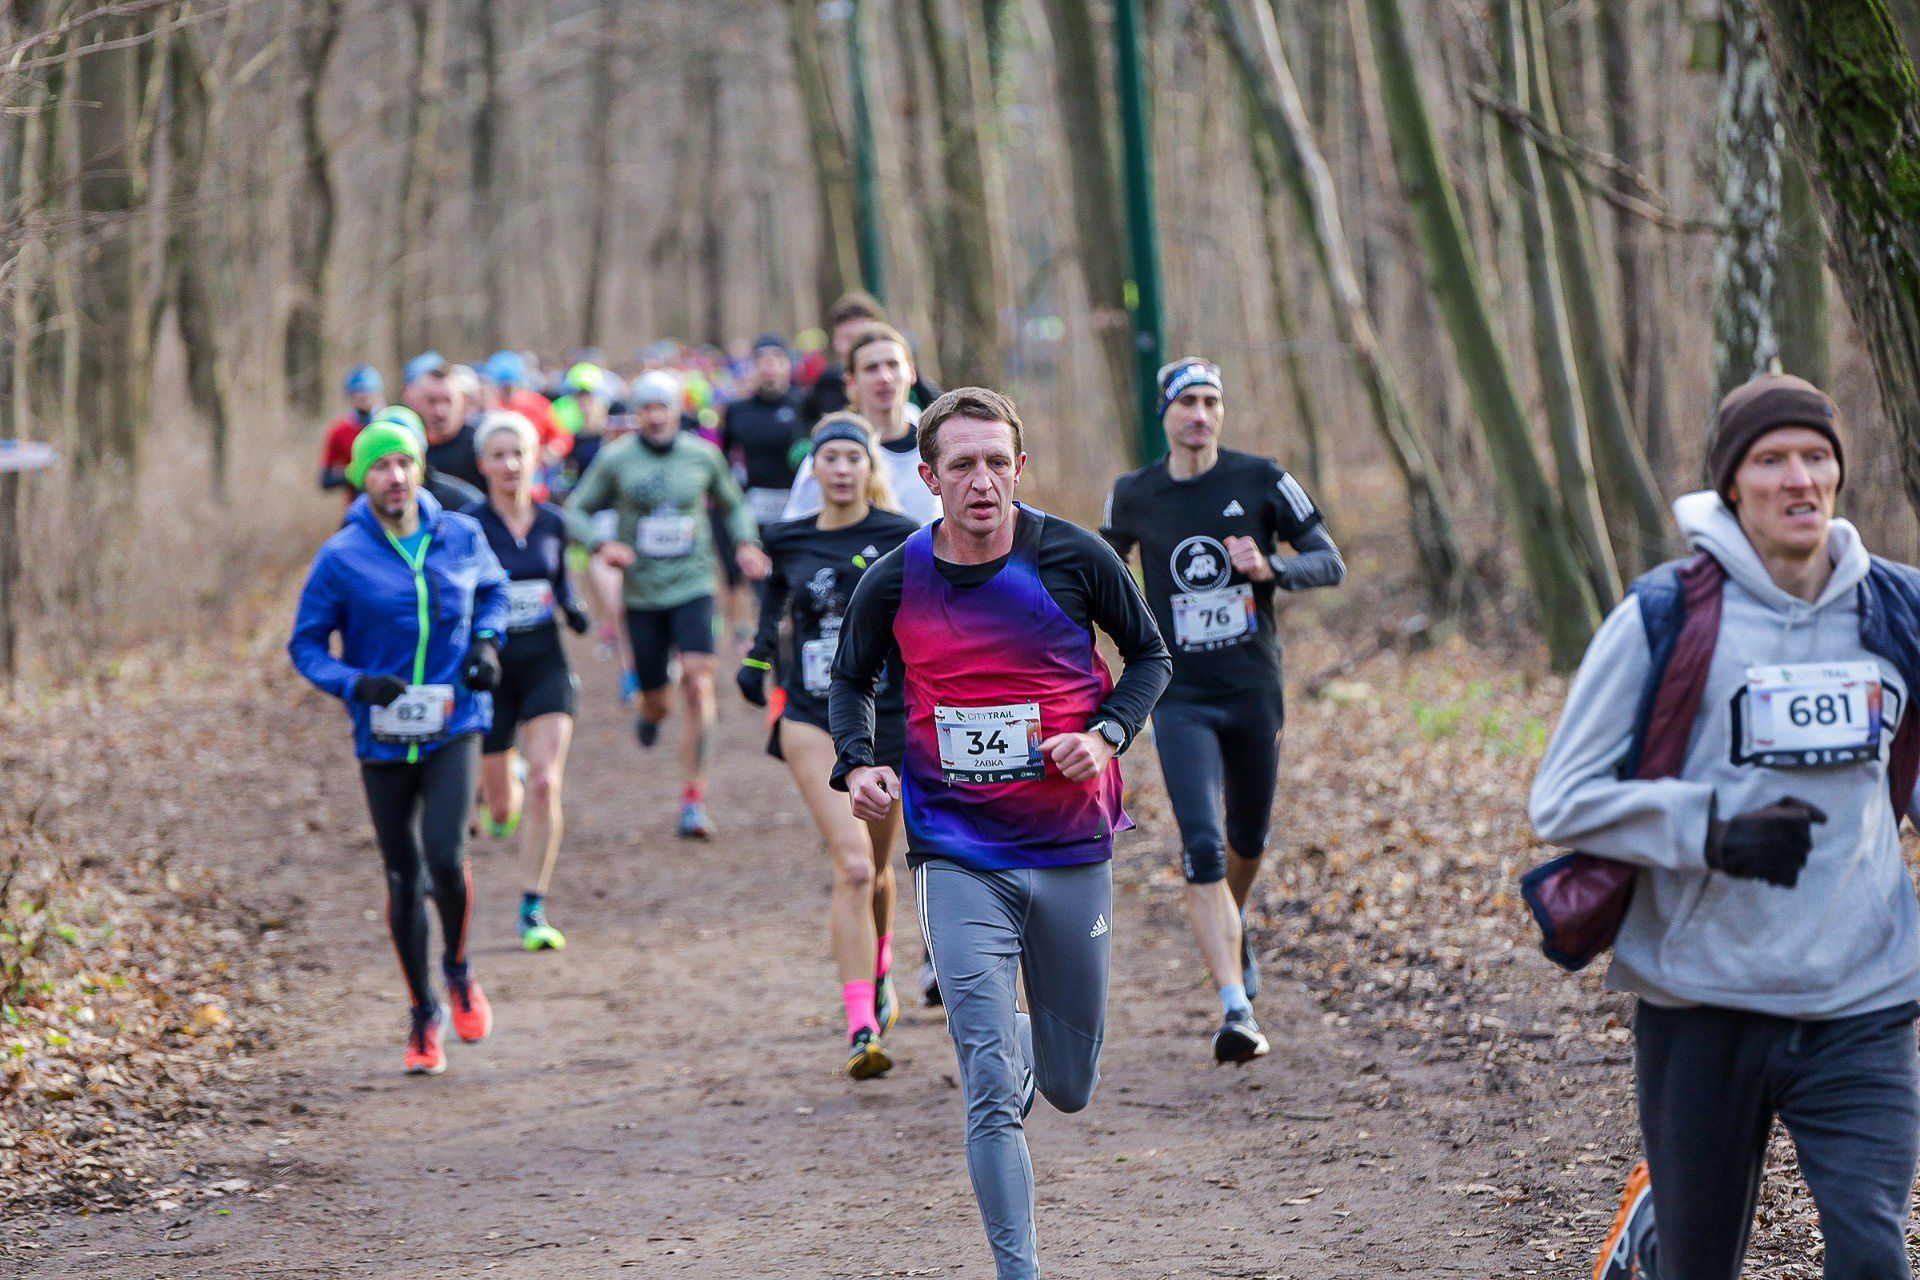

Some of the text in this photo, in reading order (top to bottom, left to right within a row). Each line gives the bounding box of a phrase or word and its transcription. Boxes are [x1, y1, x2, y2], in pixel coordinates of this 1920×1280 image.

[1199, 606, 1230, 628] 76
[1789, 693, 1852, 727] 681
[965, 730, 1009, 756] 34
[974, 758, 1004, 768] ŻABKA
